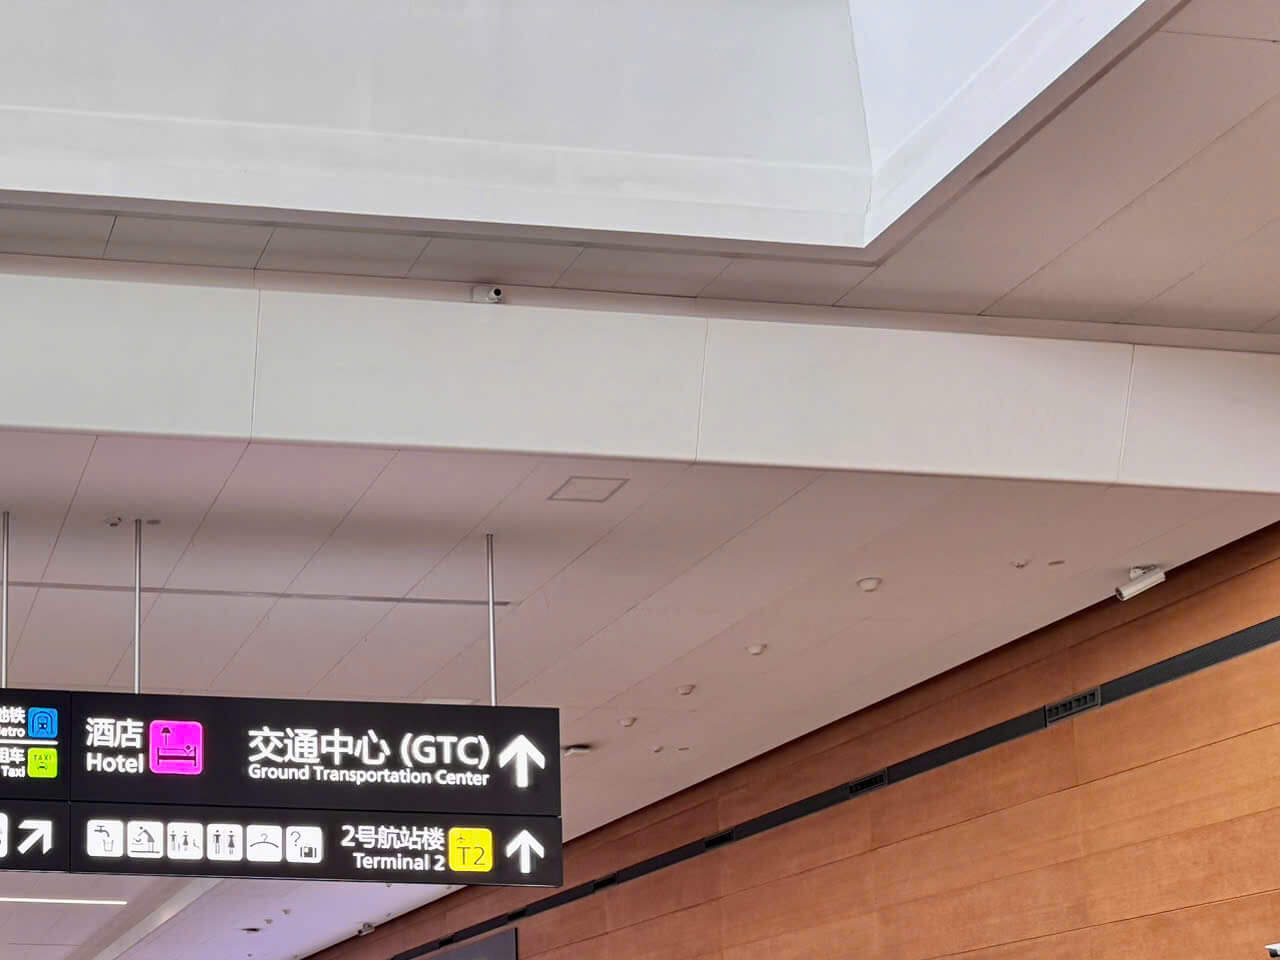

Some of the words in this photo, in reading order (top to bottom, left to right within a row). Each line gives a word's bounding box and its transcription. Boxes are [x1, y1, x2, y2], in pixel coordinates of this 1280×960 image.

[85, 717, 144, 749] 酒店
[248, 726, 391, 765] 交通中心
[400, 732, 490, 770] (GTC)
[1, 765, 26, 778] Taxi
[86, 752, 144, 774] Hotel
[248, 763, 310, 781] Ground
[313, 765, 432, 786] Transportation
[435, 769, 490, 787] Center
[340, 825, 445, 850] 2号航站楼
[352, 852, 430, 871] Terminal
[433, 854, 445, 871] 2
